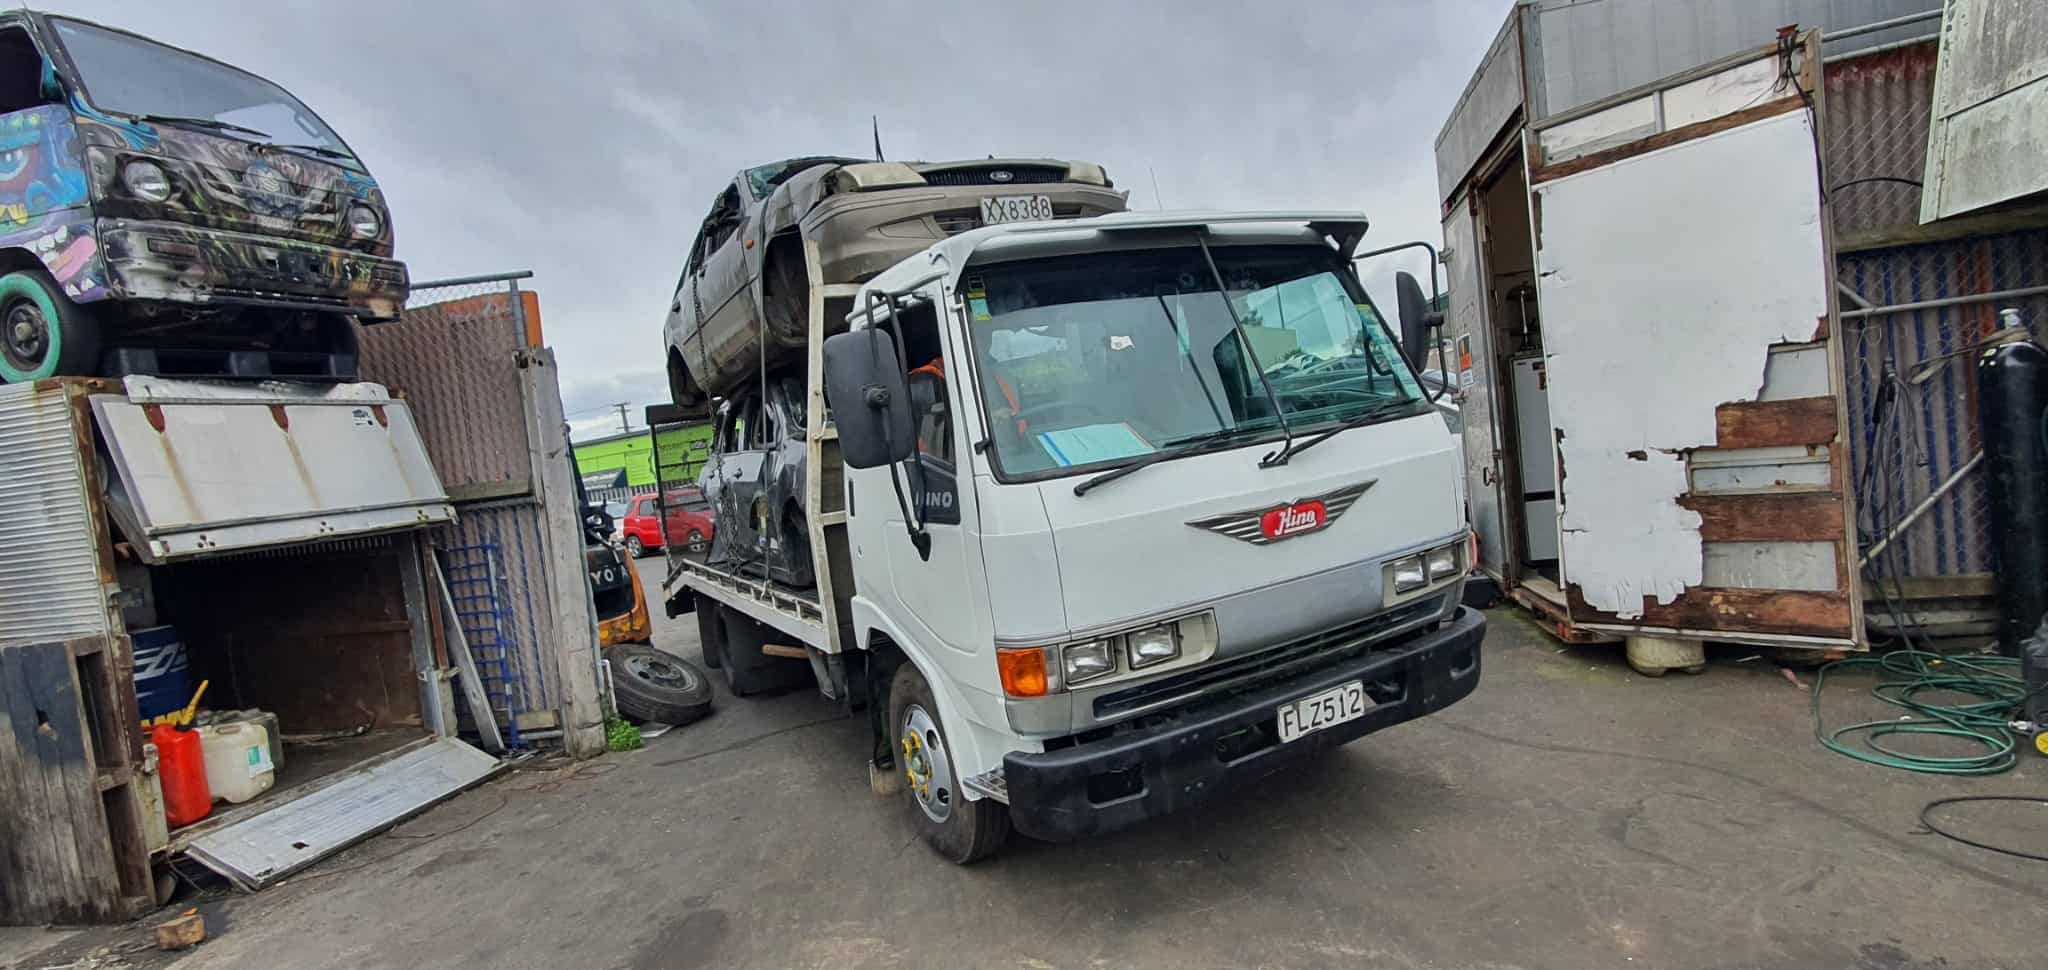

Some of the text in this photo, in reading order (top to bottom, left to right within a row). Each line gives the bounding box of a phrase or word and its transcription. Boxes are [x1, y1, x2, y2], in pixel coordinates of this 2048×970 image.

[984, 198, 1051, 221] XX8388
[1274, 507, 1317, 536] Hino
[1283, 688, 1361, 737] FLZ512
